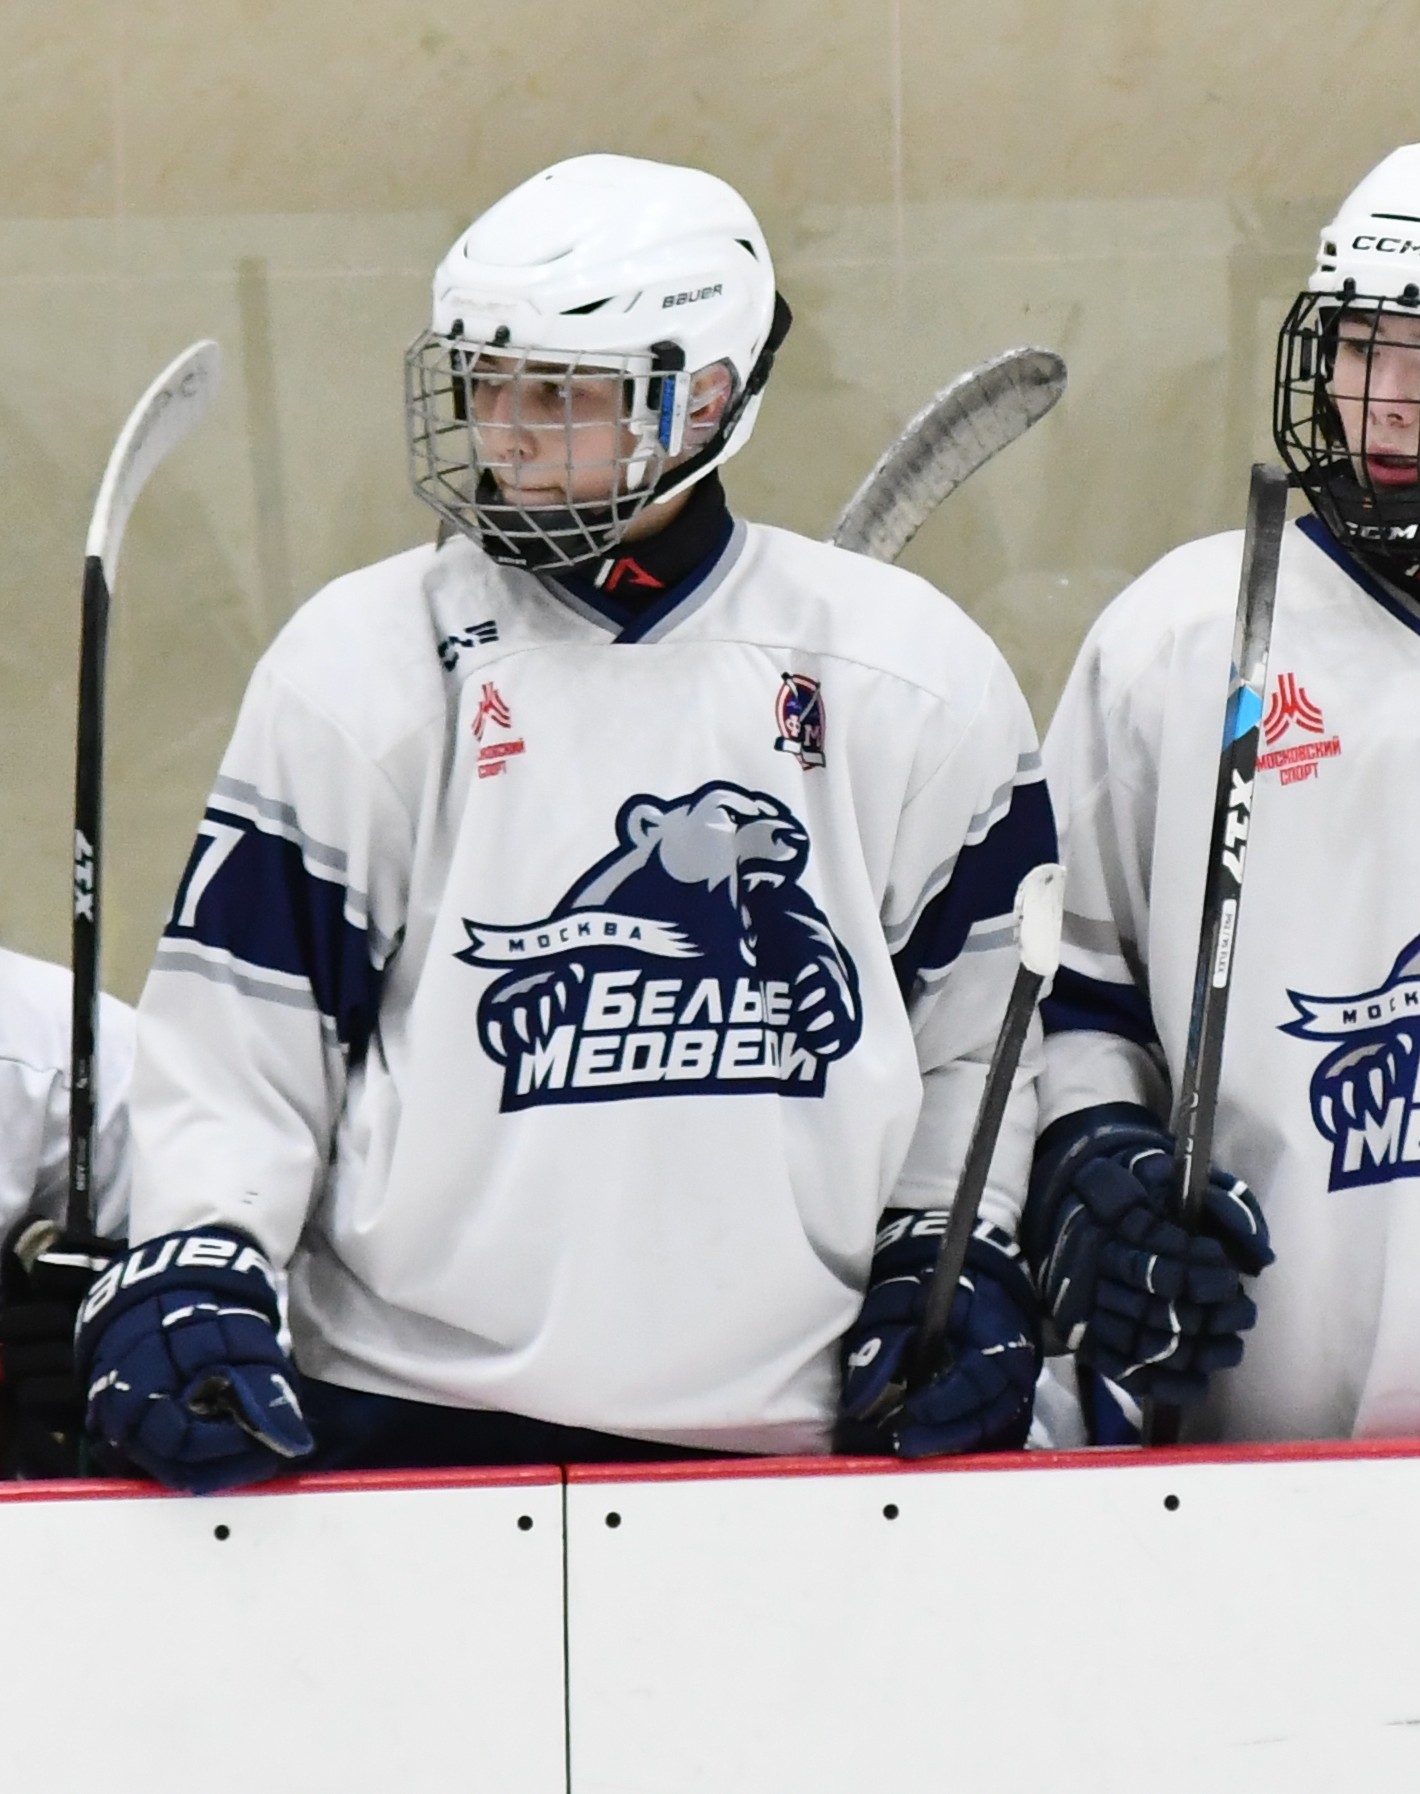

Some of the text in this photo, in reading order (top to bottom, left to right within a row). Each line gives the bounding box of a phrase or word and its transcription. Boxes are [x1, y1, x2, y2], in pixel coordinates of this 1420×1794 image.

[1280, 762, 1318, 787] СПОРТ
[508, 920, 643, 954] МОСКВА
[82, 1236, 278, 1324] AUER
